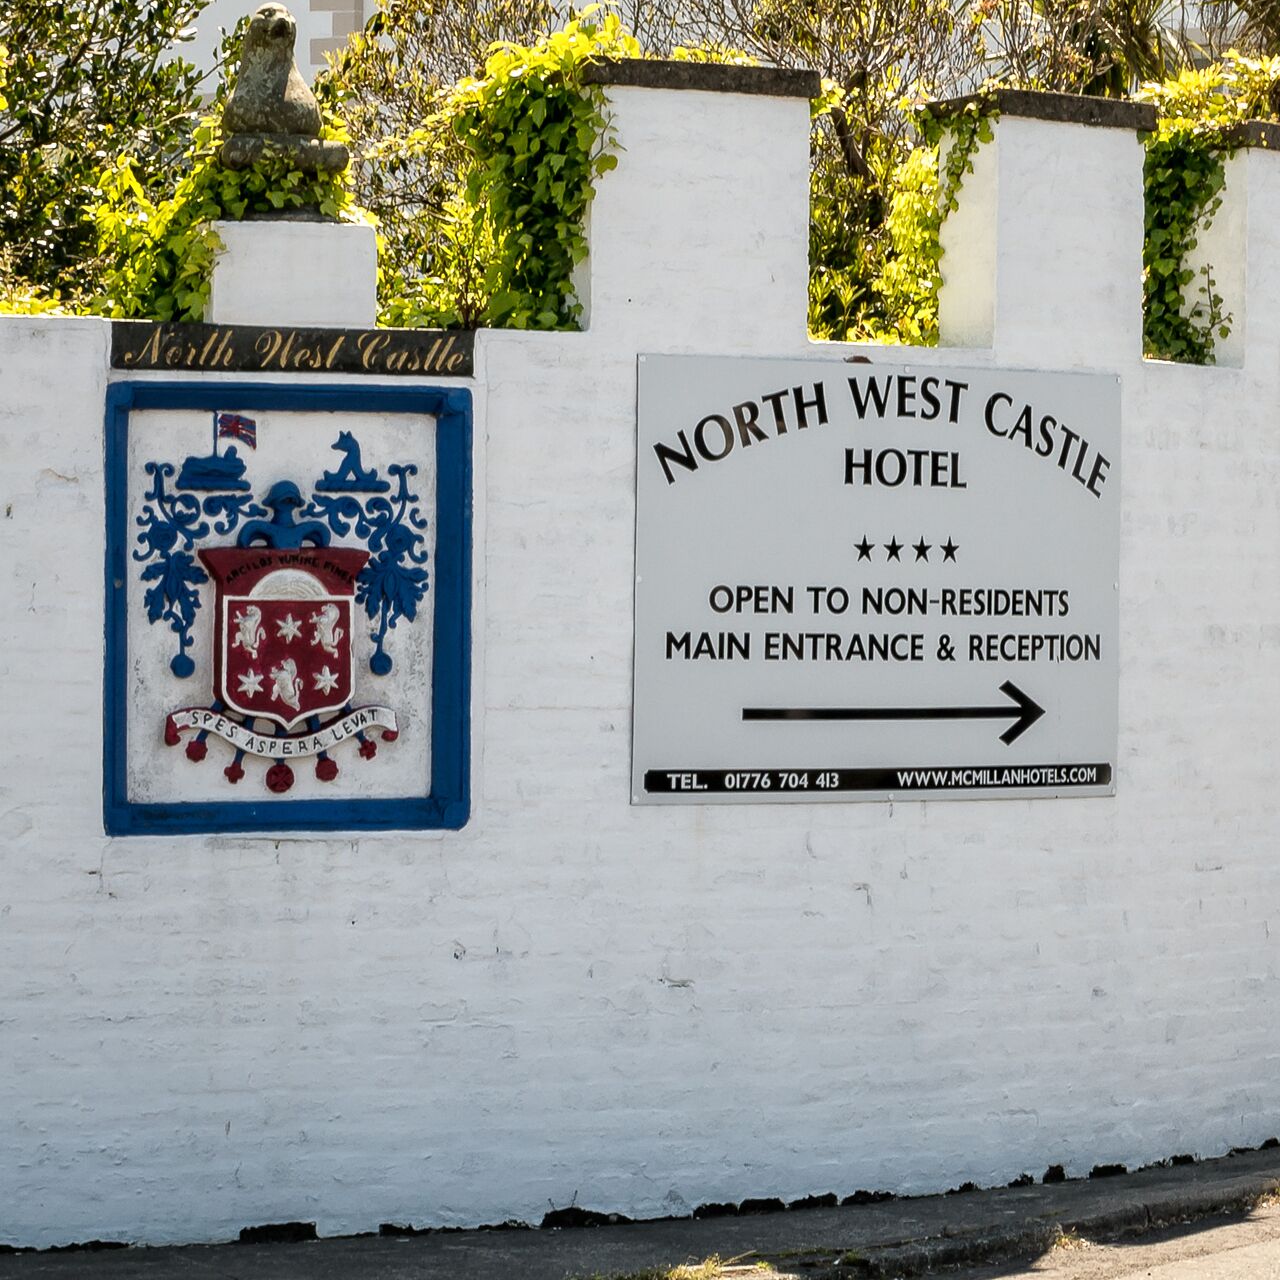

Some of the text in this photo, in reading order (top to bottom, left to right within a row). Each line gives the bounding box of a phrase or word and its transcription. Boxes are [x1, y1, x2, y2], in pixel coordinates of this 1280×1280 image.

[124, 325, 465, 372] North West Castle
[654, 376, 1110, 498] NORTH WEST CASTLE
[845, 448, 966, 488] HOTEL
[710, 586, 1068, 616] OPEN TO NON-RESIDENTS
[666, 632, 1100, 662] MAIN ENTRANCE & RECEPTION
[191, 709, 379, 755] SPES ASPERA LEVAT
[667, 767, 1097, 788] TEL. 01776 704 413 WWW.MCMILLANHOTELS.COM
